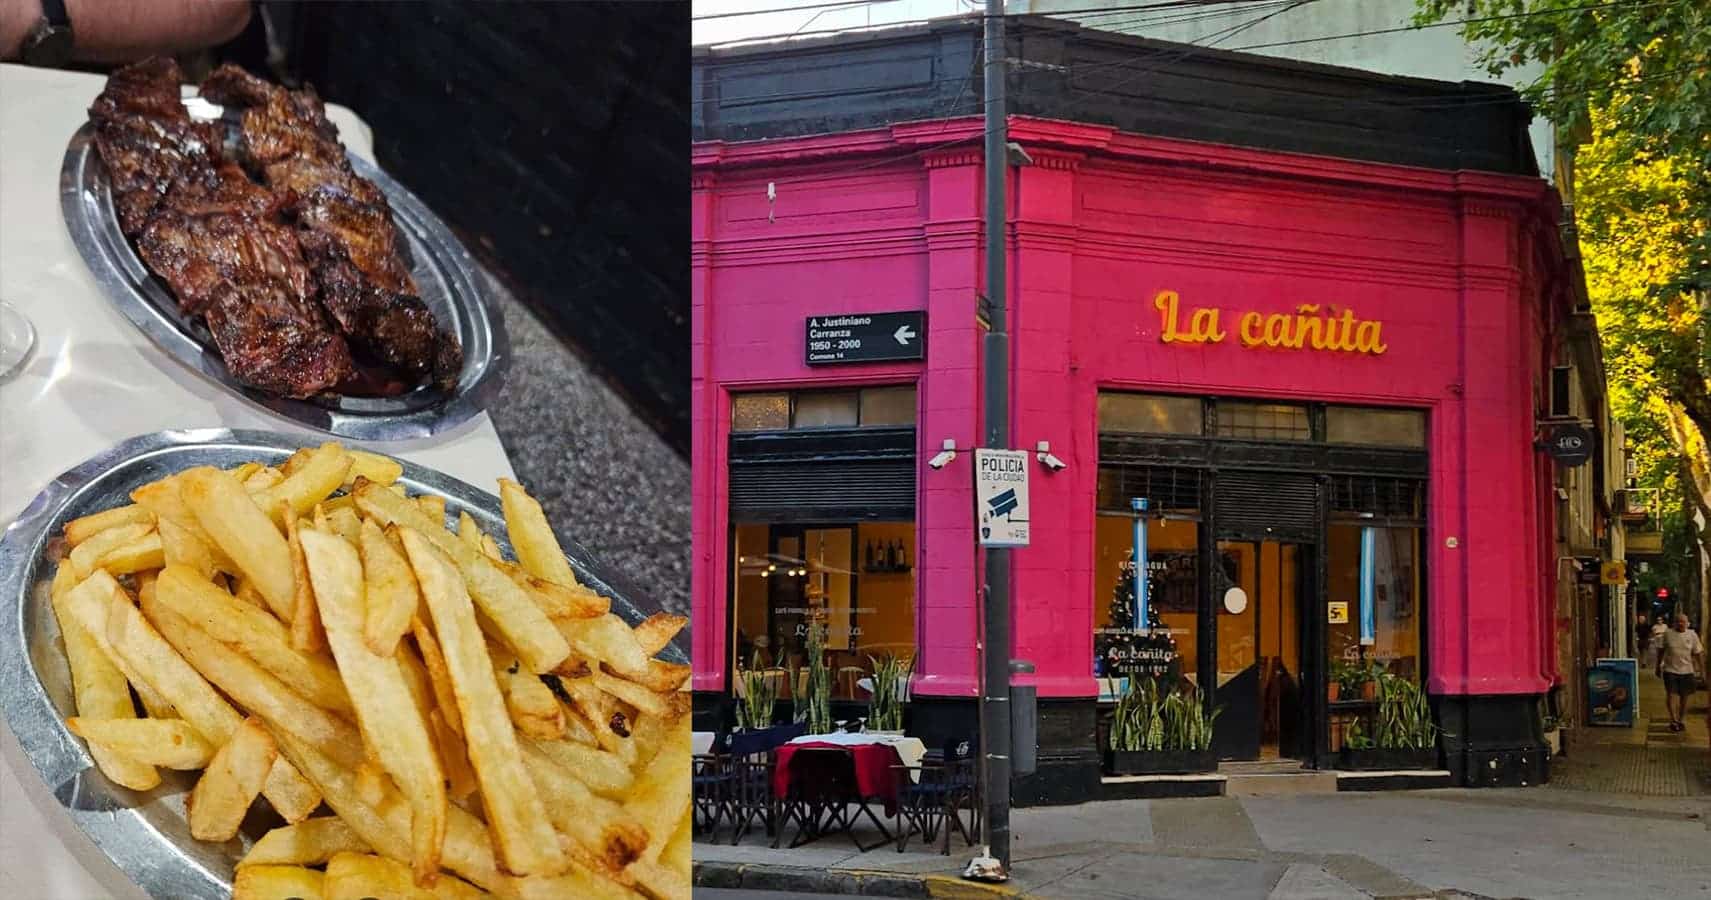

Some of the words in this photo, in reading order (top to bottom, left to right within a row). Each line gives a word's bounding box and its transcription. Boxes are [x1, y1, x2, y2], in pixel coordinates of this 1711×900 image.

[810, 318, 820, 327] A.
[822, 316, 871, 327] Justiniano
[1155, 290, 1226, 344] La
[1240, 303, 1388, 354] cañita
[810, 329, 851, 338] Carranza
[810, 341, 831, 350] 1950
[838, 340, 861, 349] 2000
[981, 458, 1024, 472] POLICIA
[981, 472, 991, 480] DE
